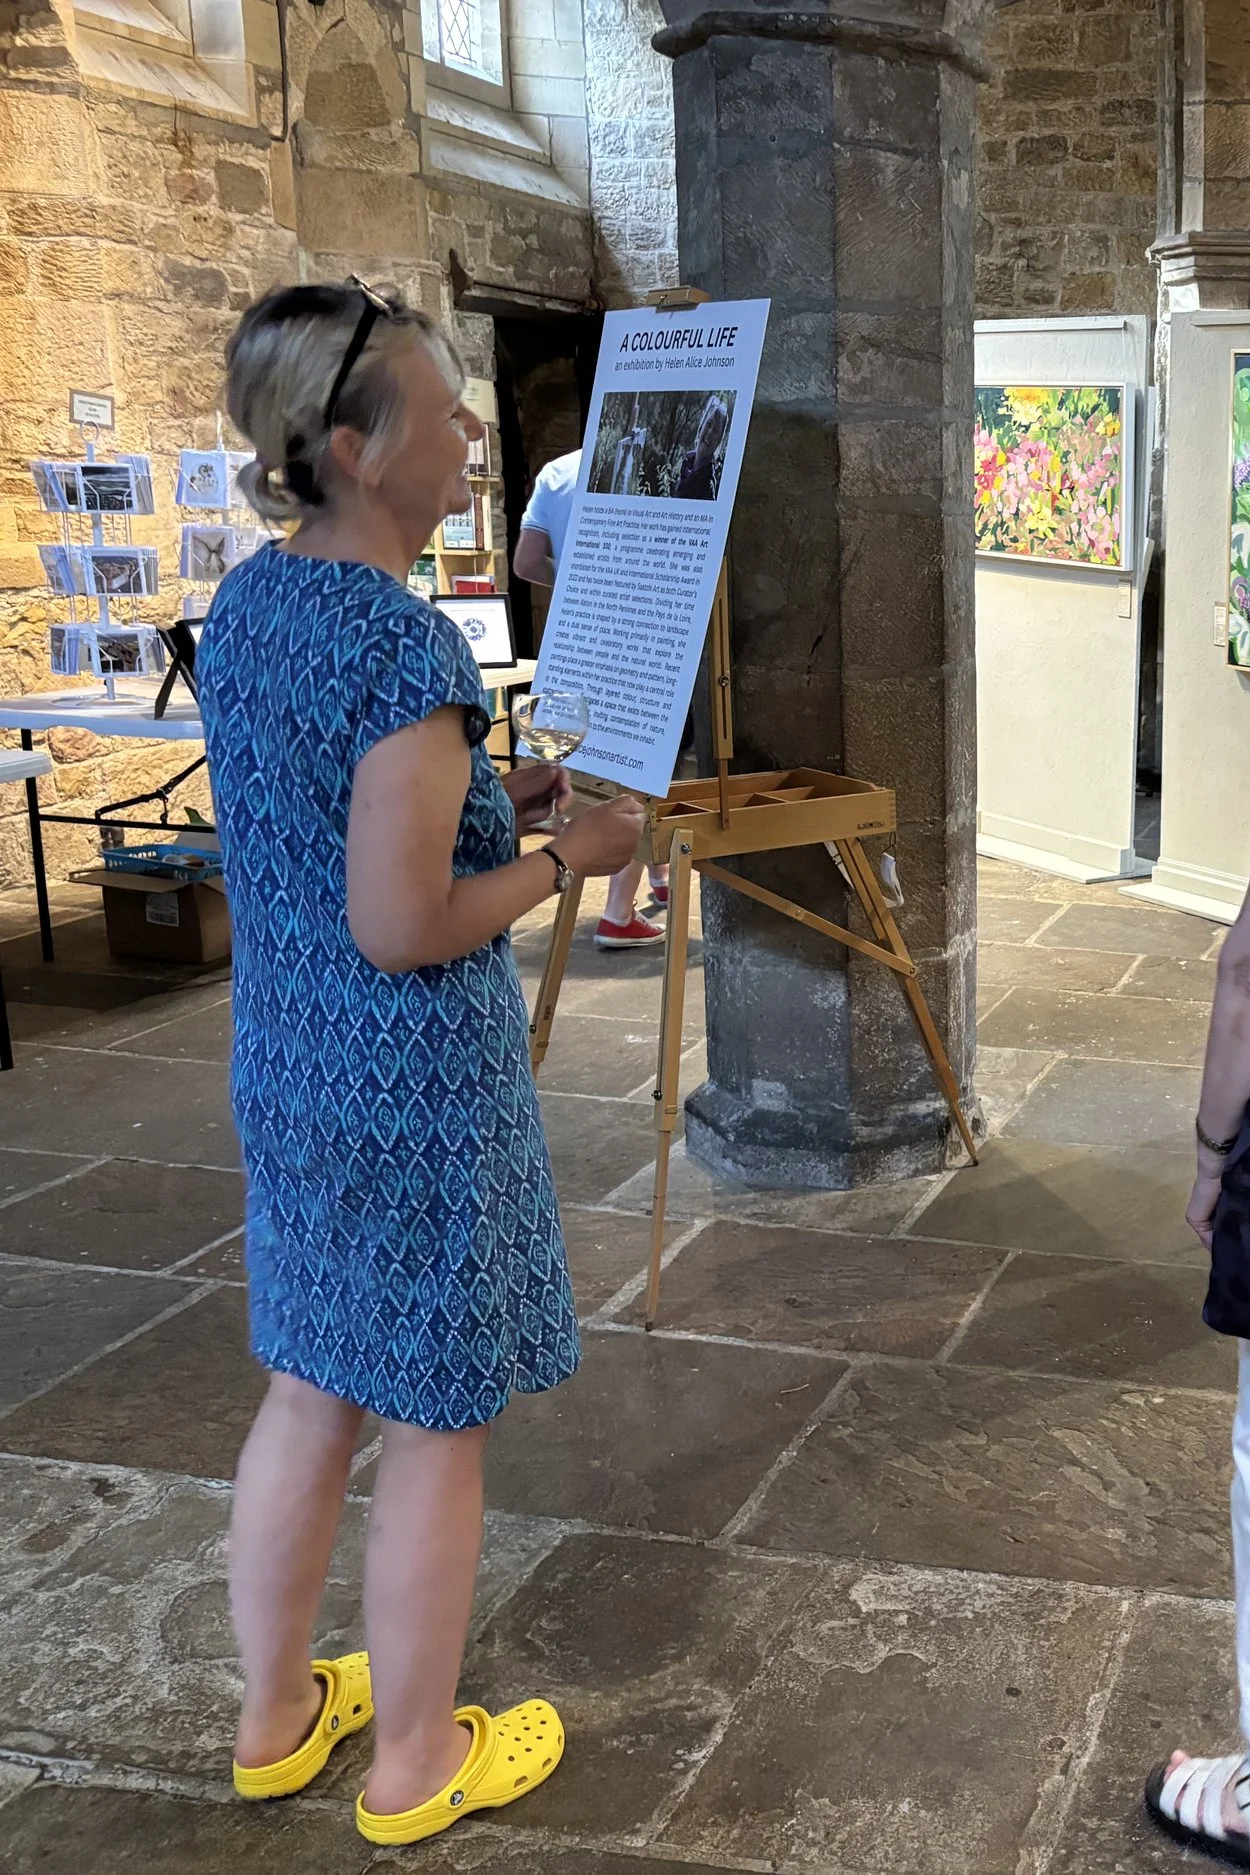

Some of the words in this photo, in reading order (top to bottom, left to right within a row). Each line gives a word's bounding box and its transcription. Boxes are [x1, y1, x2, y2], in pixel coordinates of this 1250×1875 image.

[619, 333, 629, 352] A
[631, 328, 703, 352] COLOURFUL
[707, 326, 738, 347] LIFE
[615, 362, 623, 371] an
[623, 358, 654, 371] exhibition
[655, 357, 664, 372] by
[665, 357, 684, 369] Helen
[685, 356, 702, 368] Alice
[703, 355, 735, 368] Johnson
[578, 742, 644, 771] cejohnsonartist.com
